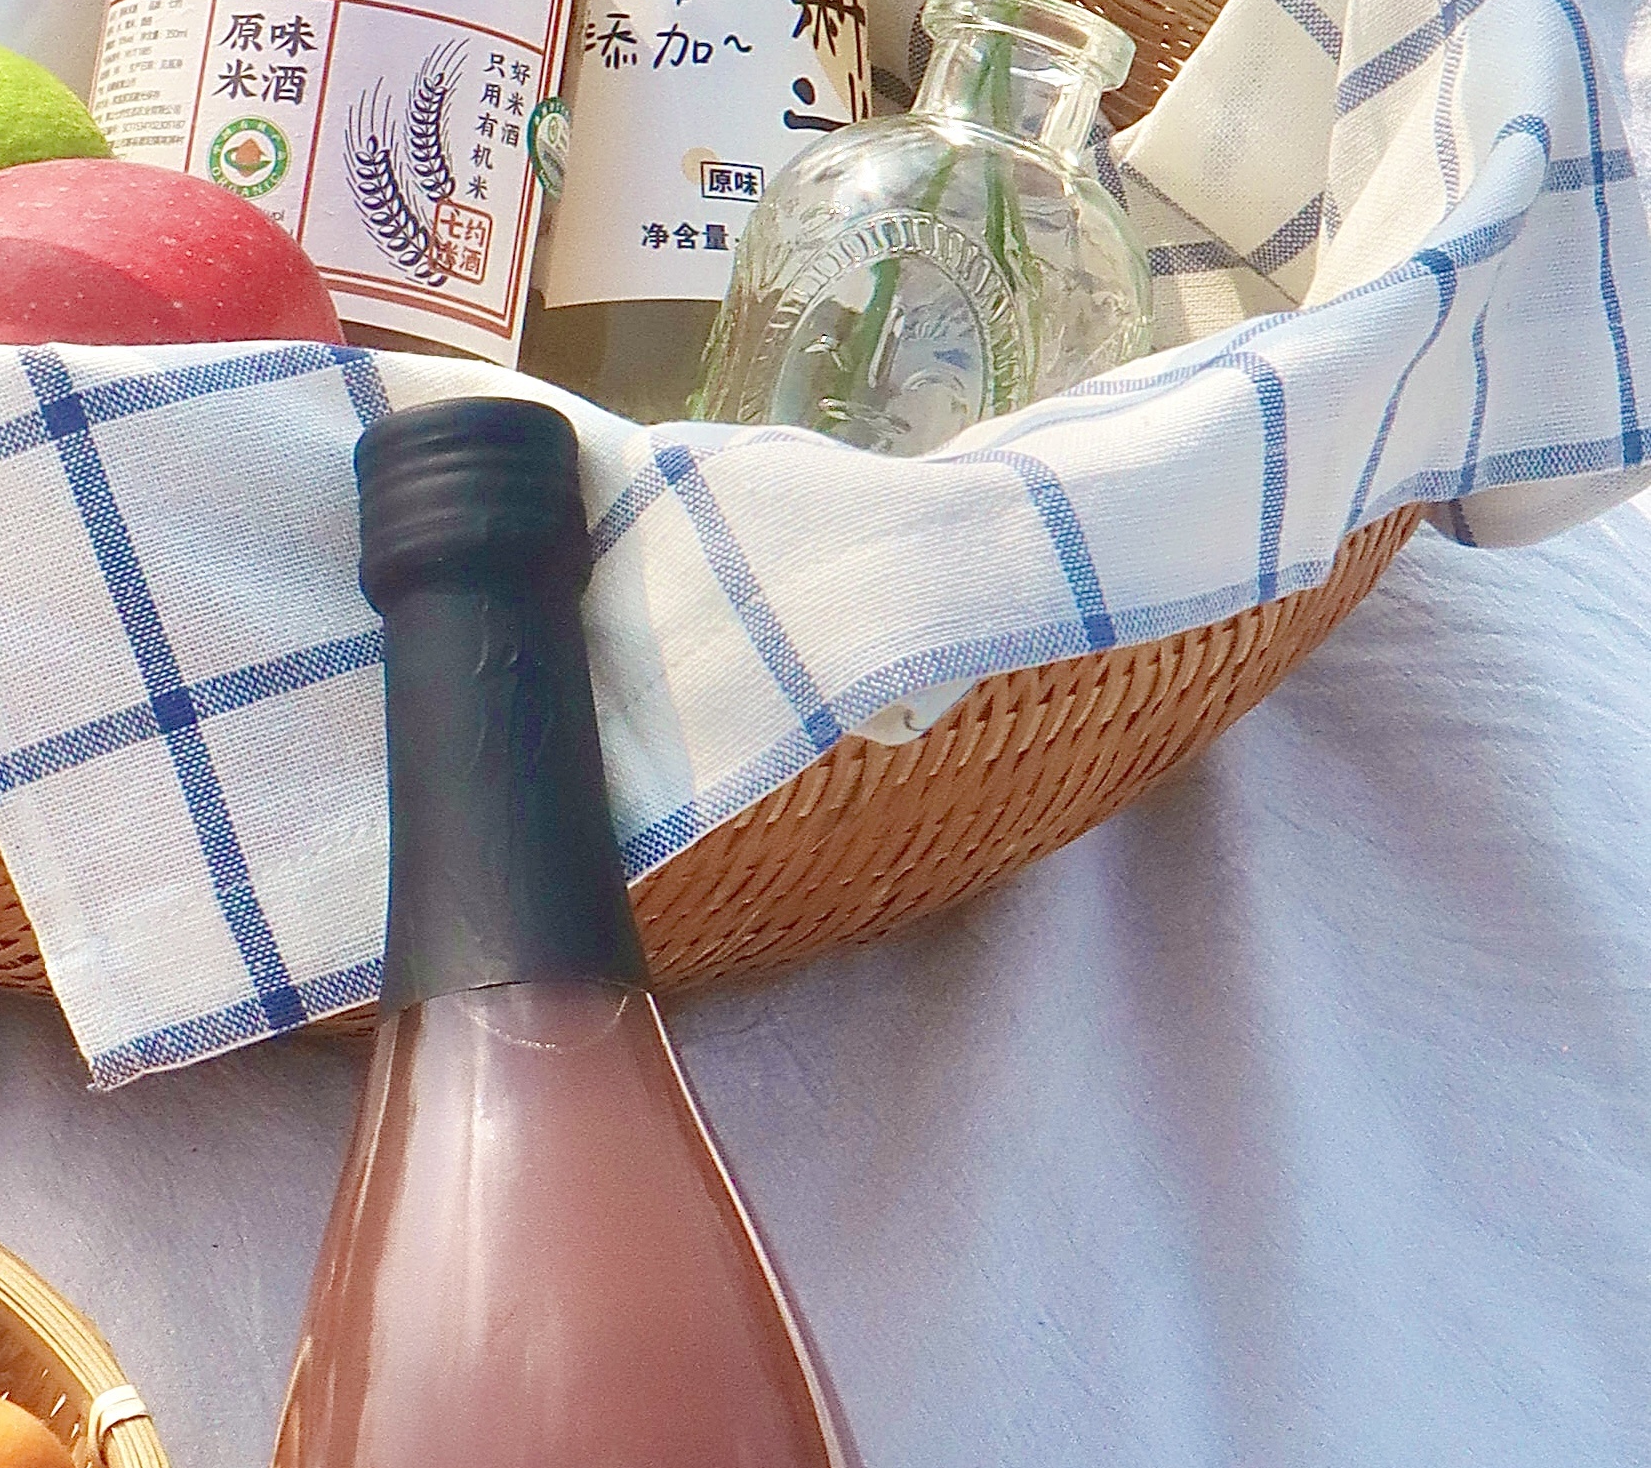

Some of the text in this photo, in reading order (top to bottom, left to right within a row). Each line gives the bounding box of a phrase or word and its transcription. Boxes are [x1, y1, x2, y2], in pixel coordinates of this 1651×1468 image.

[218, 13, 318, 58] 原味
[212, 58, 308, 105] 米酒
[465, 53, 506, 201] 只用有机米
[501, 62, 531, 148] 好米酒
[709, 169, 758, 195] 原味
[440, 209, 486, 248] 七约
